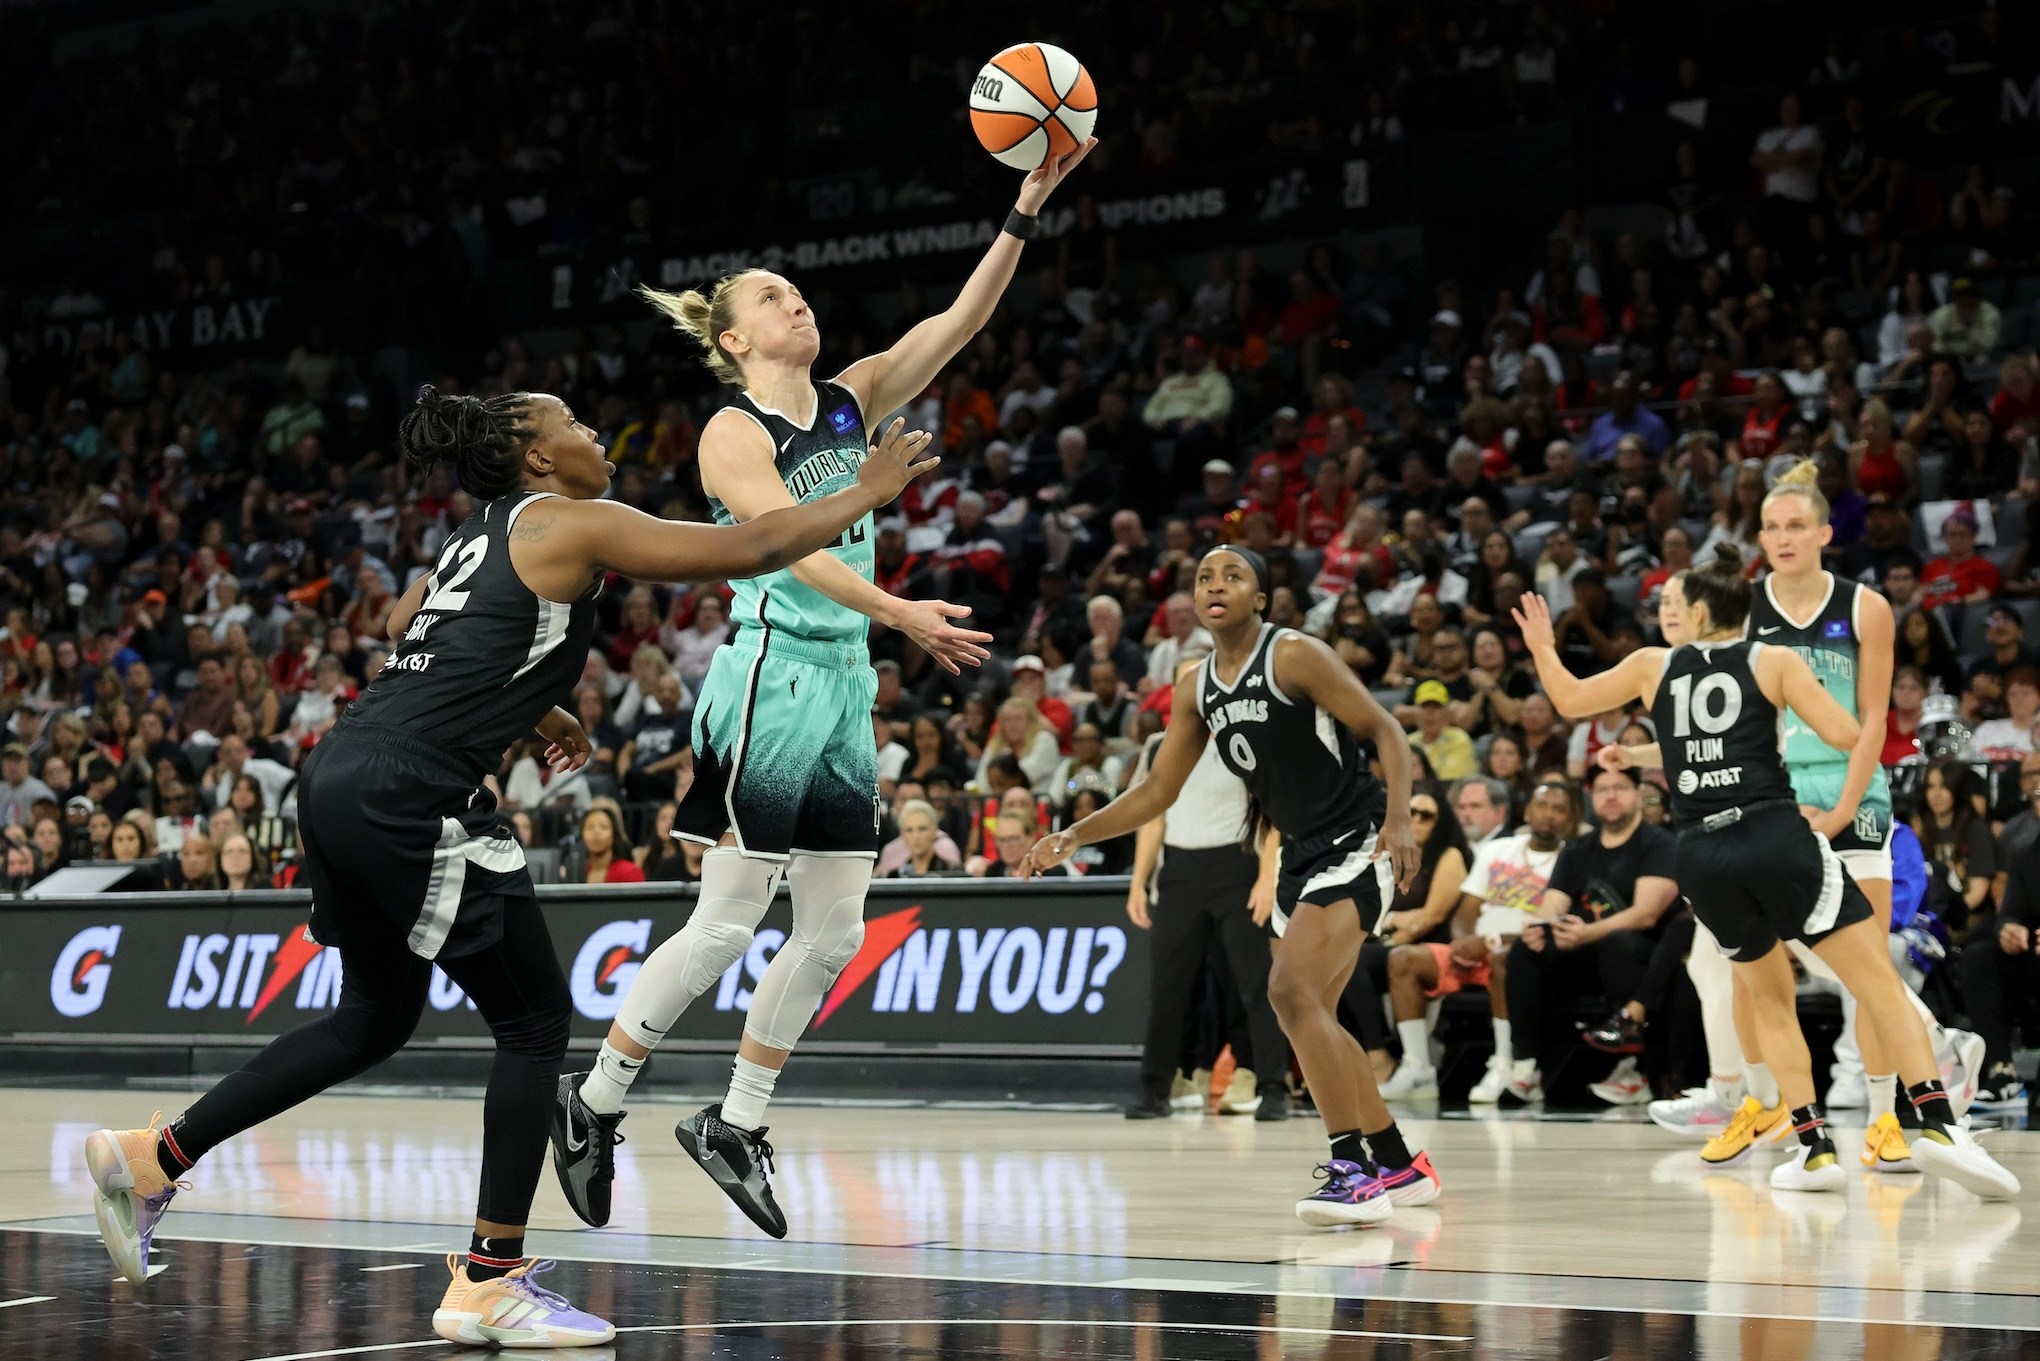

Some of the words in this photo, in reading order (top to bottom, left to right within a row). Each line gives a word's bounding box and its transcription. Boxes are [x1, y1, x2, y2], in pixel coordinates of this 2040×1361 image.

[894, 217, 998, 257] WNBA
[191, 297, 273, 347] BAY
[418, 533, 490, 612] 12
[1224, 698, 1270, 725] VEGAS
[1669, 671, 1743, 738] 10
[1228, 732, 1258, 772] 0
[1685, 737, 1724, 764] PLUM
[1699, 766, 1743, 789] AT&T
[49, 924, 122, 1018] G
[167, 933, 230, 1010] IS
[217, 934, 280, 1009] IT
[570, 918, 654, 1021] G
[871, 927, 951, 1012] IN
[955, 925, 1127, 1014] YOU?
